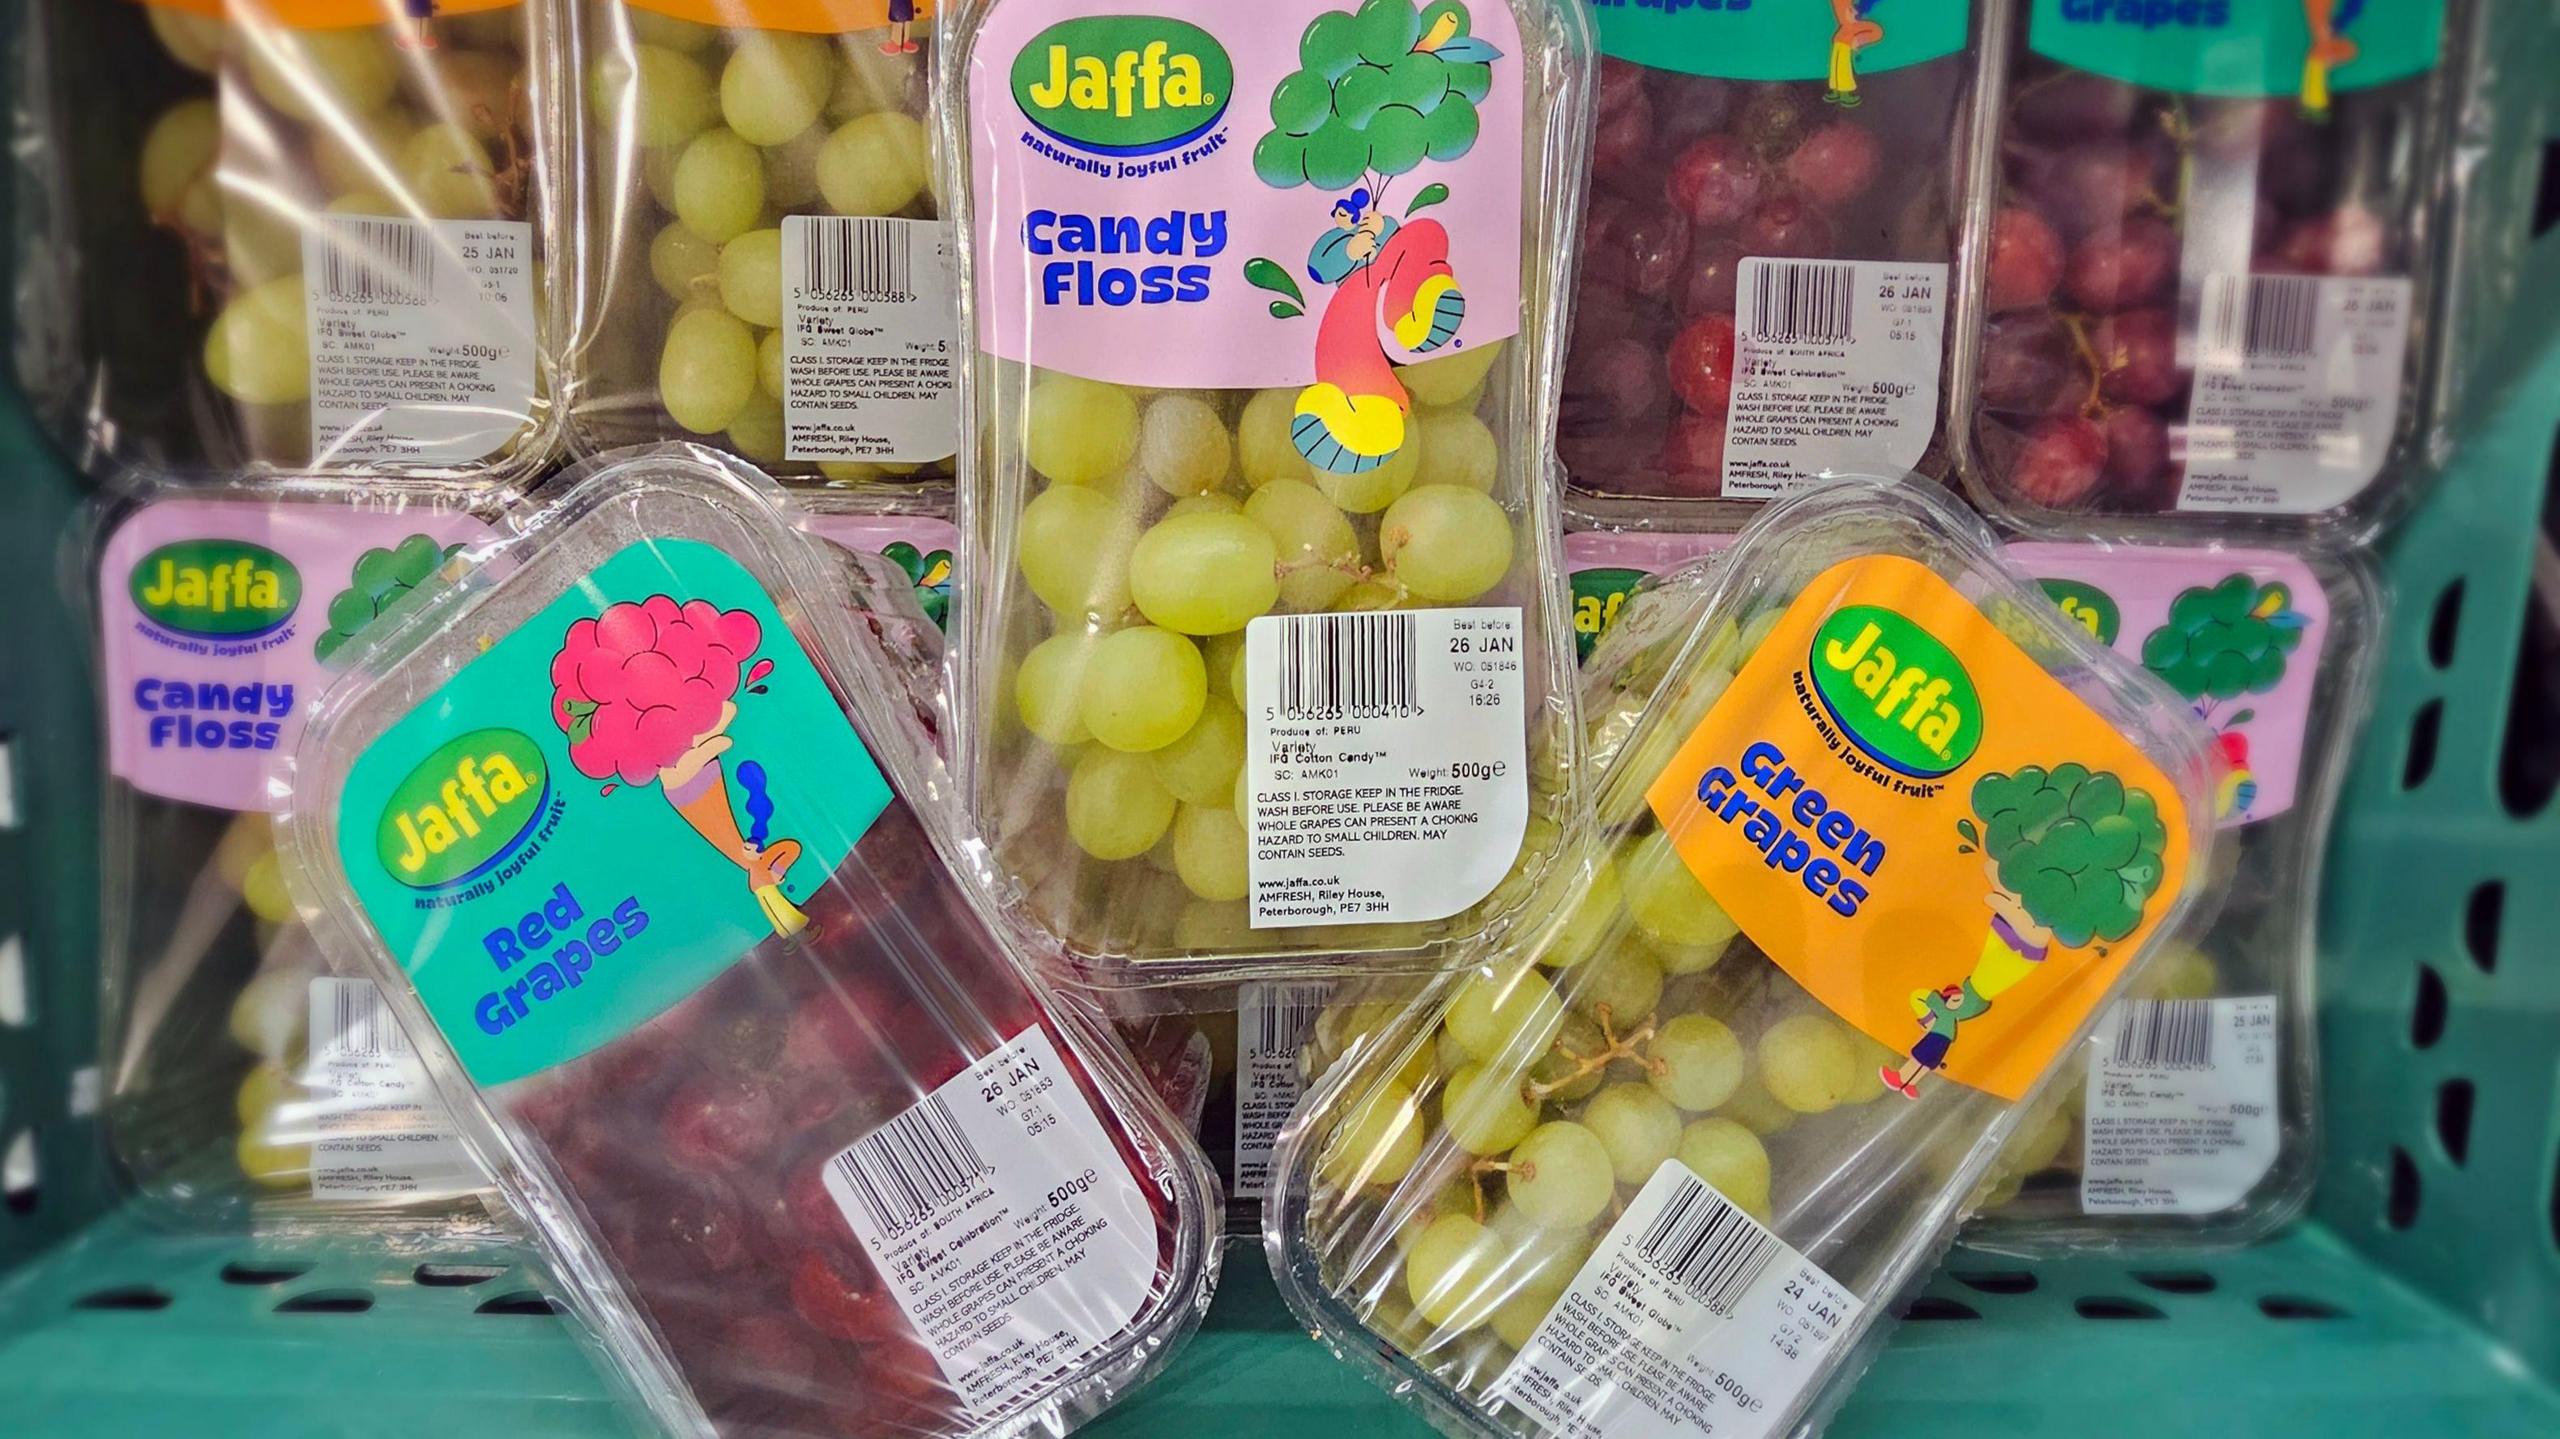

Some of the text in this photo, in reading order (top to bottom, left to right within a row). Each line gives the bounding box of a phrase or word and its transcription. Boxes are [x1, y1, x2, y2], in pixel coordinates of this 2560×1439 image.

[1020, 131, 1111, 178] naturally
[1117, 156, 1177, 178] joyful
[1020, 209, 1227, 257] Candy
[461, 245, 514, 259] 25 JAN
[1043, 260, 1211, 306] Floss
[1878, 284, 1931, 299] 26 JAN
[135, 621, 209, 655] naturally
[212, 644, 258, 656] joyful
[1449, 636, 1513, 653] 26 JAN
[135, 678, 294, 717] Candy
[1469, 692, 1500, 706] 16:26
[149, 715, 281, 750] Floss
[1269, 726, 1310, 737] Produce
[1333, 724, 1361, 735] PERU
[1793, 671, 1841, 750] naturally
[1838, 747, 1891, 787] joyful
[1270, 753, 1288, 764] IFQ
[1296, 752, 1333, 764] Cotton
[1272, 741, 1316, 755] Variety
[1301, 767, 1338, 779] AMK01
[1256, 790, 1291, 803] CLASS
[1302, 787, 1352, 801] STORAGE
[1354, 787, 1383, 799] KEEP
[1384, 786, 1396, 798] IN
[1398, 786, 1421, 798] THE
[1256, 805, 1289, 817] WASH
[1291, 803, 1334, 816] BEFORE
[1362, 800, 1403, 813] PLEASE
[1405, 800, 1421, 812] BE
[1422, 798, 1461, 811] AWARE
[1741, 741, 1886, 877] Green
[1256, 811, 1478, 831] WHOLE GRAPES CAN PRESENT A CHOKING
[1257, 833, 1304, 846] HAZARD
[1305, 832, 1322, 844] TO
[1323, 830, 1361, 843] SMALL
[1422, 828, 1448, 840] MAY
[1257, 847, 1305, 860] CONTAIN
[1697, 766, 1869, 918] Grapes
[415, 879, 495, 910] naturally
[495, 841, 541, 886] joyful
[1257, 874, 1340, 890] www.jaffa.co.uk
[1317, 889, 1345, 902] Riley
[1339, 901, 1361, 913] PE7
[1364, 900, 1389, 912] 3HH
[482, 881, 584, 973] Red
[474, 896, 650, 1036] Grapes
[980, 1056, 1040, 1103] 26 JAN
[1026, 1115, 1056, 1136] 05:15
[911, 1290, 942, 1314] CLASS
[947, 1259, 991, 1292] STORAGE
[988, 1244, 1012, 1265] KEEP
[918, 1214, 1086, 1326] WASH BEFORE PLEASE AWARE
[925, 1217, 1108, 1337] WHOLE GRAPES CHOKING
[933, 1247, 1086, 1349] HAZARD SMALL MAY
[1561, 1300, 1589, 1326] WASH
[1569, 1291, 1599, 1316] CLASS
[1783, 1279, 1842, 1328] 24 JAN
[941, 1330, 983, 1360] CONTAIN
[1537, 1334, 1576, 1367] CONTAIN
[1544, 1322, 1682, 1426] HAZARD MAY
[1553, 1311, 1713, 1434] WHOLE PRESENT CHOKING
